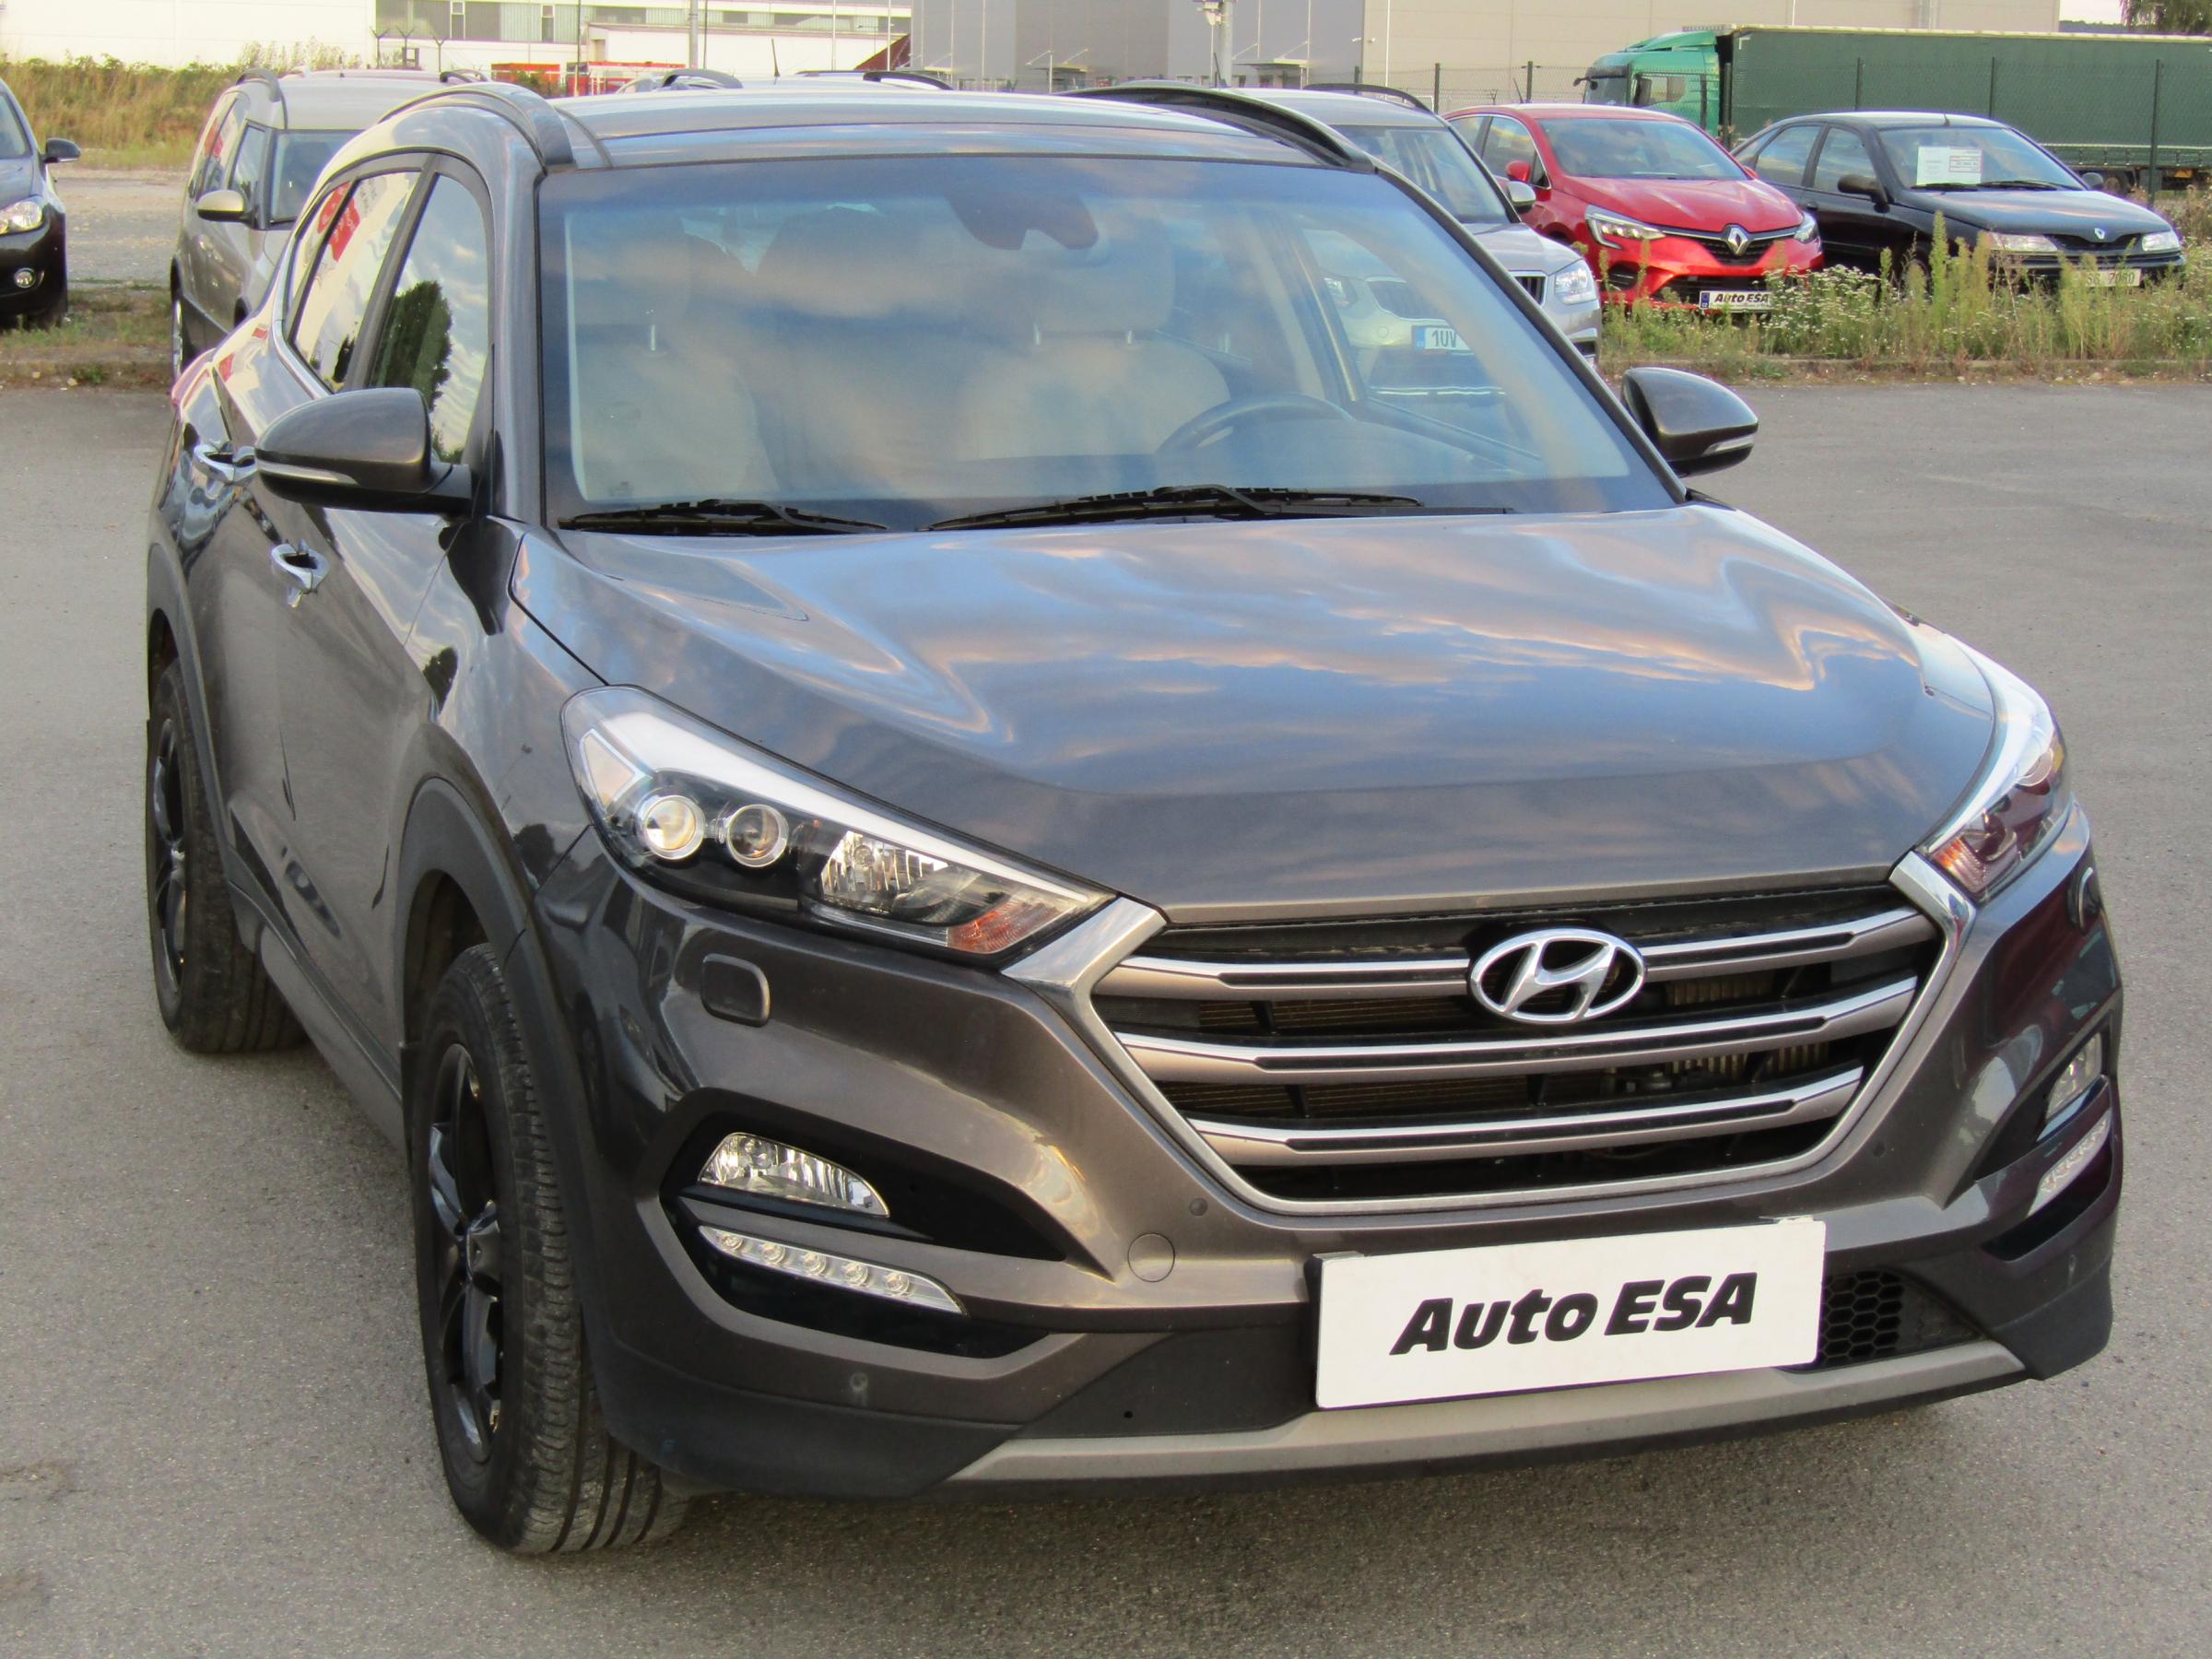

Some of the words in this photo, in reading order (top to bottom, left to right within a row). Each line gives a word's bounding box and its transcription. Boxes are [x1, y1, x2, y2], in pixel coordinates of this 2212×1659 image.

[1714, 293, 1746, 303] Auto
[1746, 292, 1770, 303] ESA
[1431, 330, 1457, 347] 1UV
[1389, 1289, 1598, 1356] Auto
[1604, 1272, 1758, 1335] ESA
